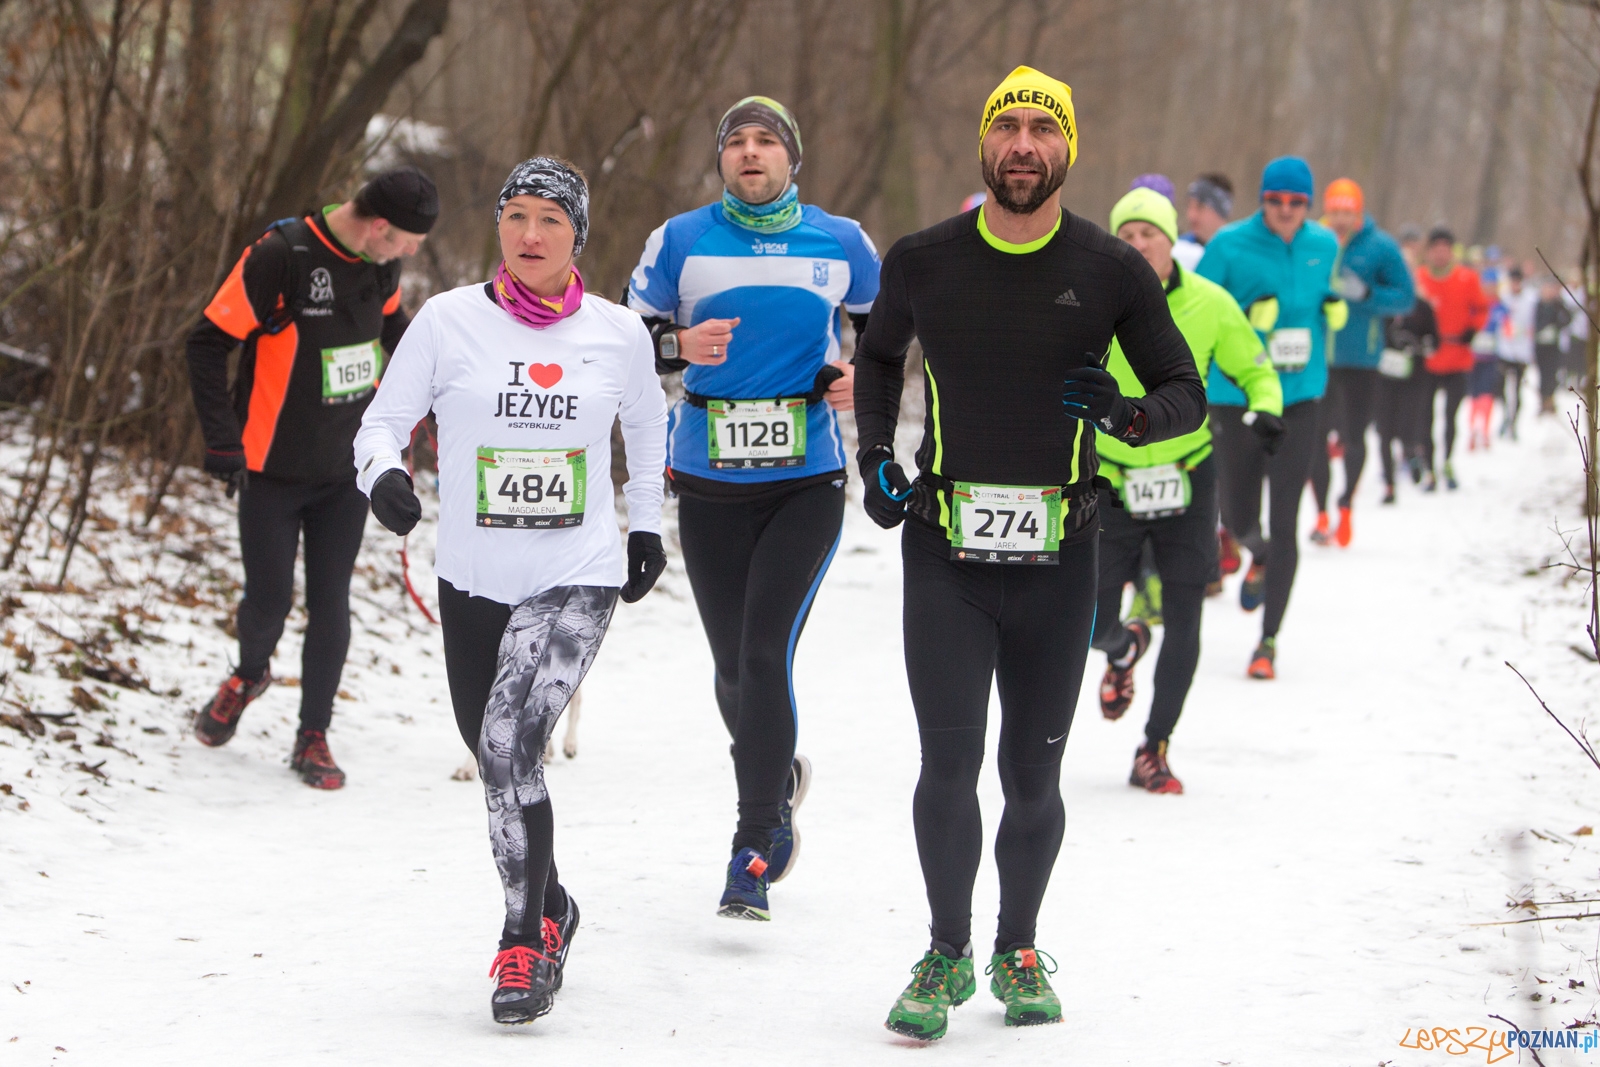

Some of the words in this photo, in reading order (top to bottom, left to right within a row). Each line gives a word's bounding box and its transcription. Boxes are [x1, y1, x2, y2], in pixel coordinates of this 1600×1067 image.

[1055, 298, 1080, 307] adidas
[337, 360, 371, 384] 1619
[508, 361, 525, 386] I
[494, 389, 579, 420] JEŻYCE
[507, 422, 561, 431] #SZYBKIJEZ
[726, 421, 788, 447] 1128
[498, 474, 567, 503] 484
[1131, 479, 1180, 503] 1477
[508, 506, 557, 514] MAGDALENA
[974, 508, 1038, 539] 274
